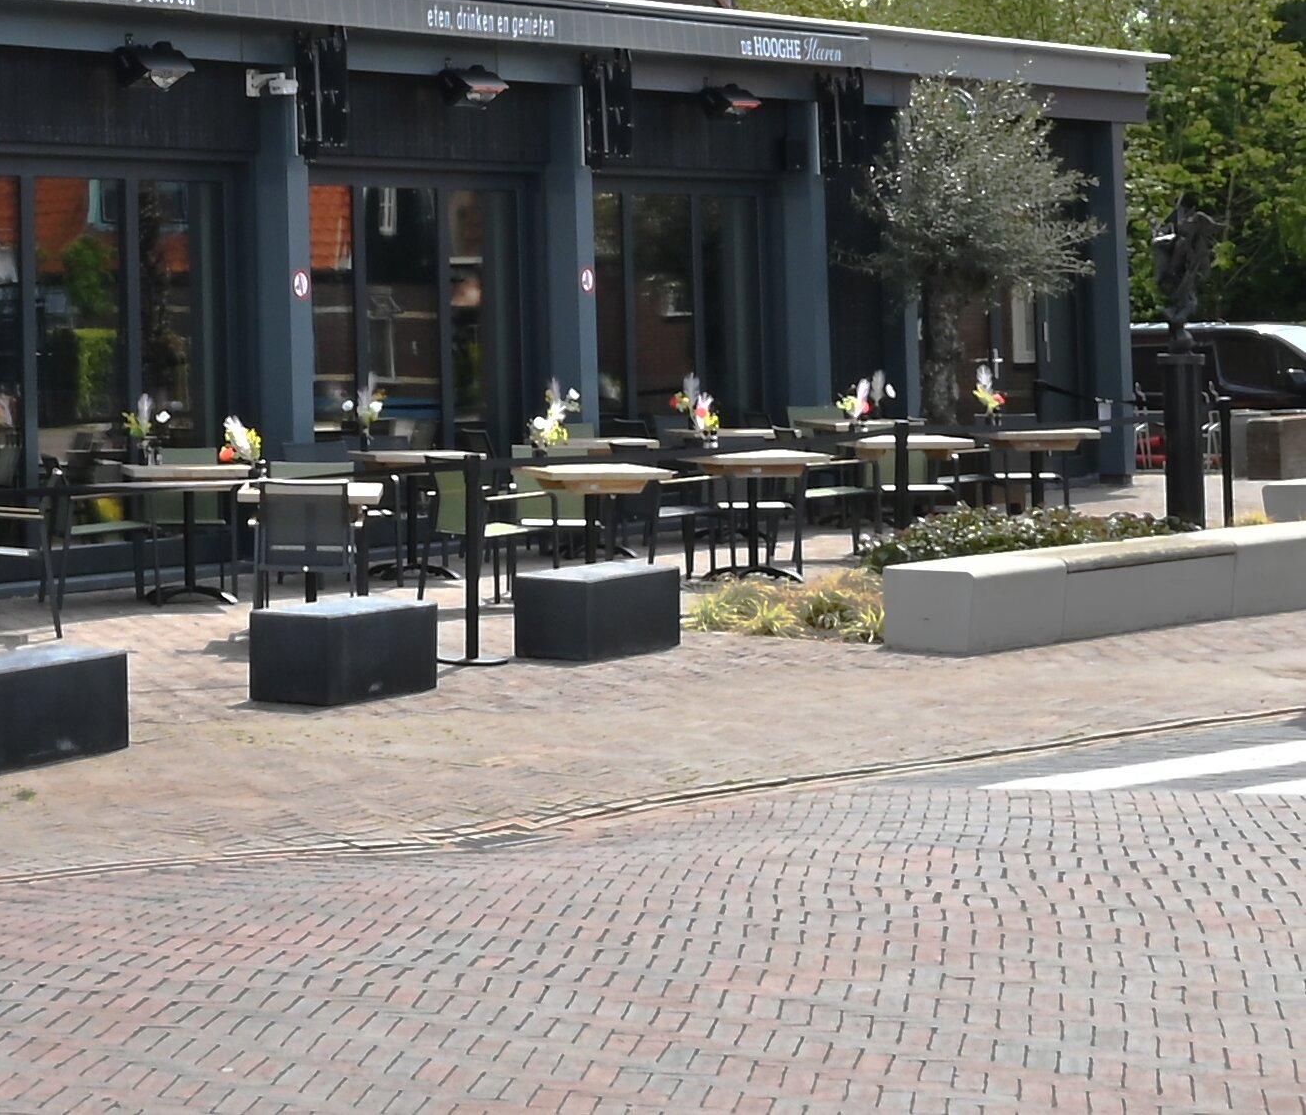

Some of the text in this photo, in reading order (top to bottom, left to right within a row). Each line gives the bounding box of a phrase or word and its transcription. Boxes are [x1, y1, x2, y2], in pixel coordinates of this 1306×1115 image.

[457, 5, 493, 31] drinken
[498, 16, 509, 33] en
[512, 11, 554, 38] genieten
[740, 40, 752, 55] DE
[753, 36, 801, 60] HOOGHE
